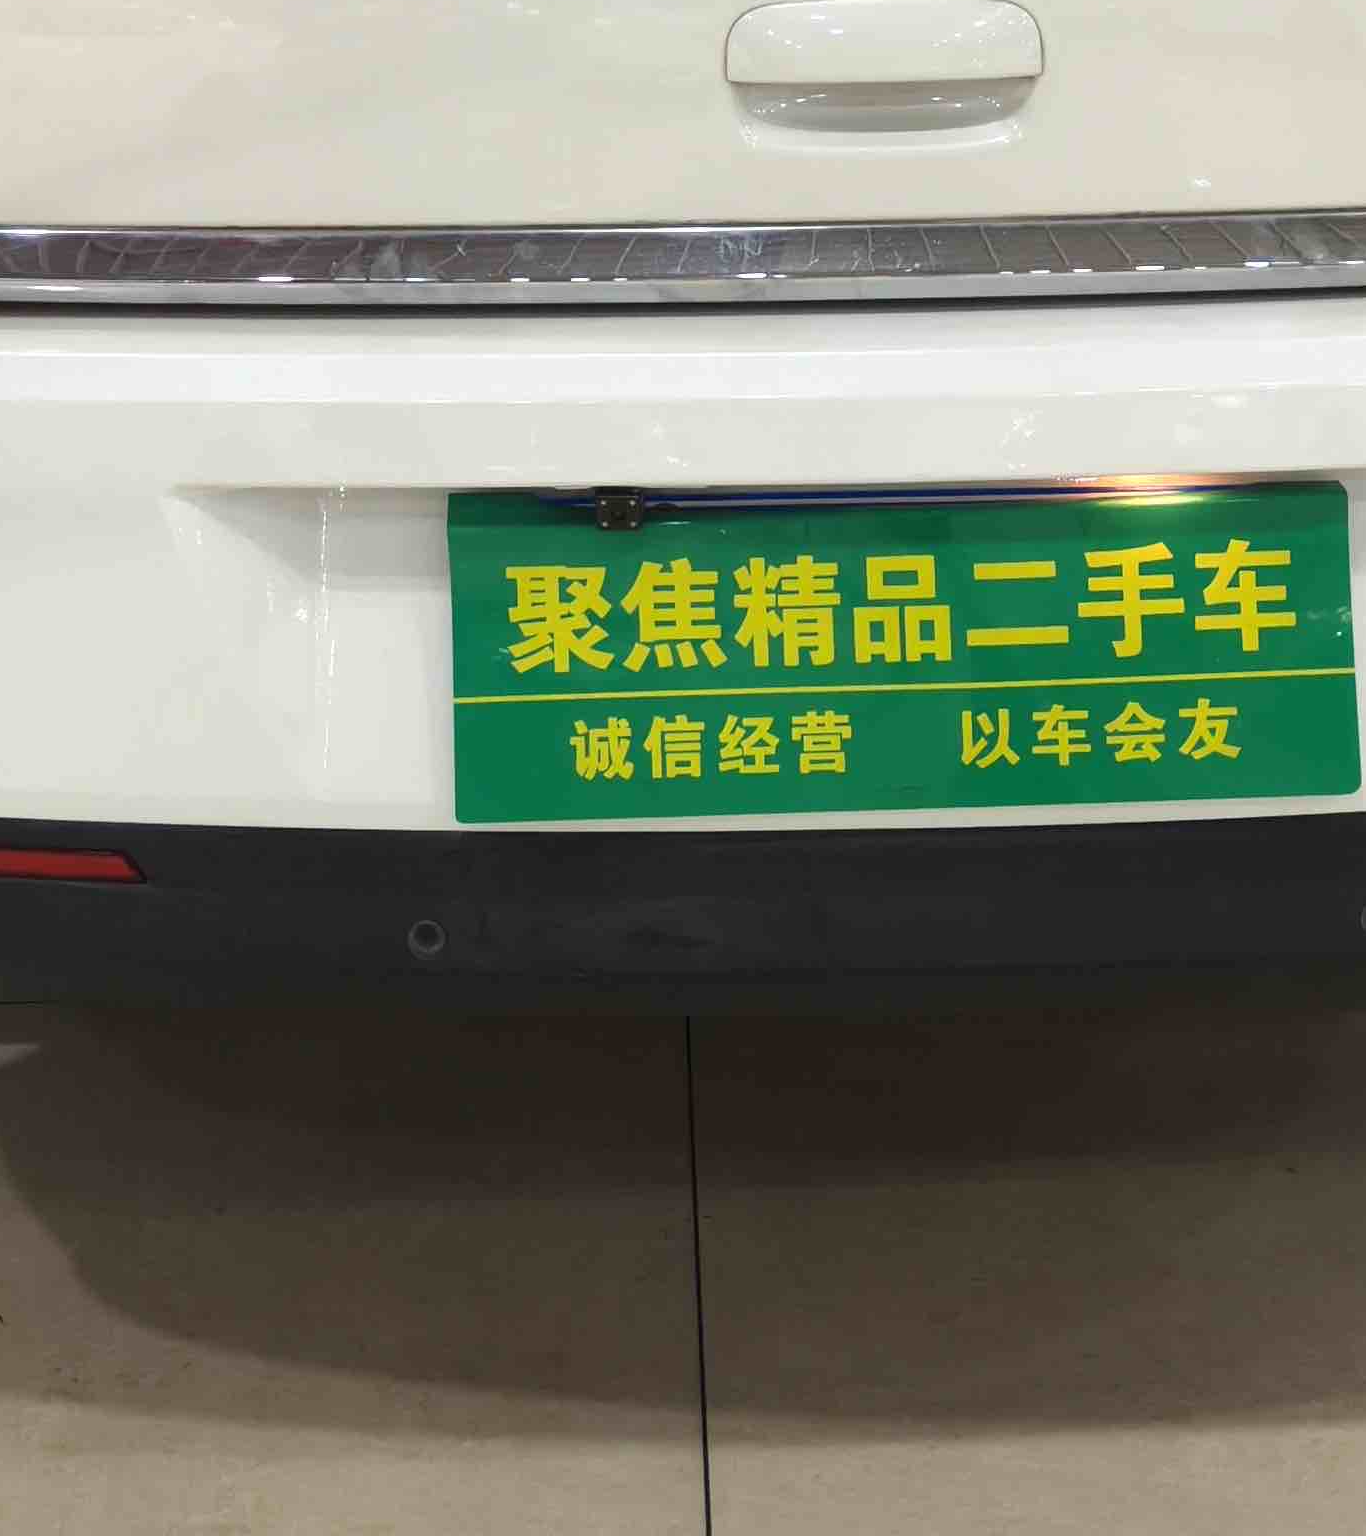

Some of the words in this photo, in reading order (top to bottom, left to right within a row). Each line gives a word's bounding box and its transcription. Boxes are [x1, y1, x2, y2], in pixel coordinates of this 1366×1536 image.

[505, 539, 1297, 672] 聚焦精品二手车
[571, 711, 851, 779] 诚信经营
[962, 699, 1239, 768] 以车会友
